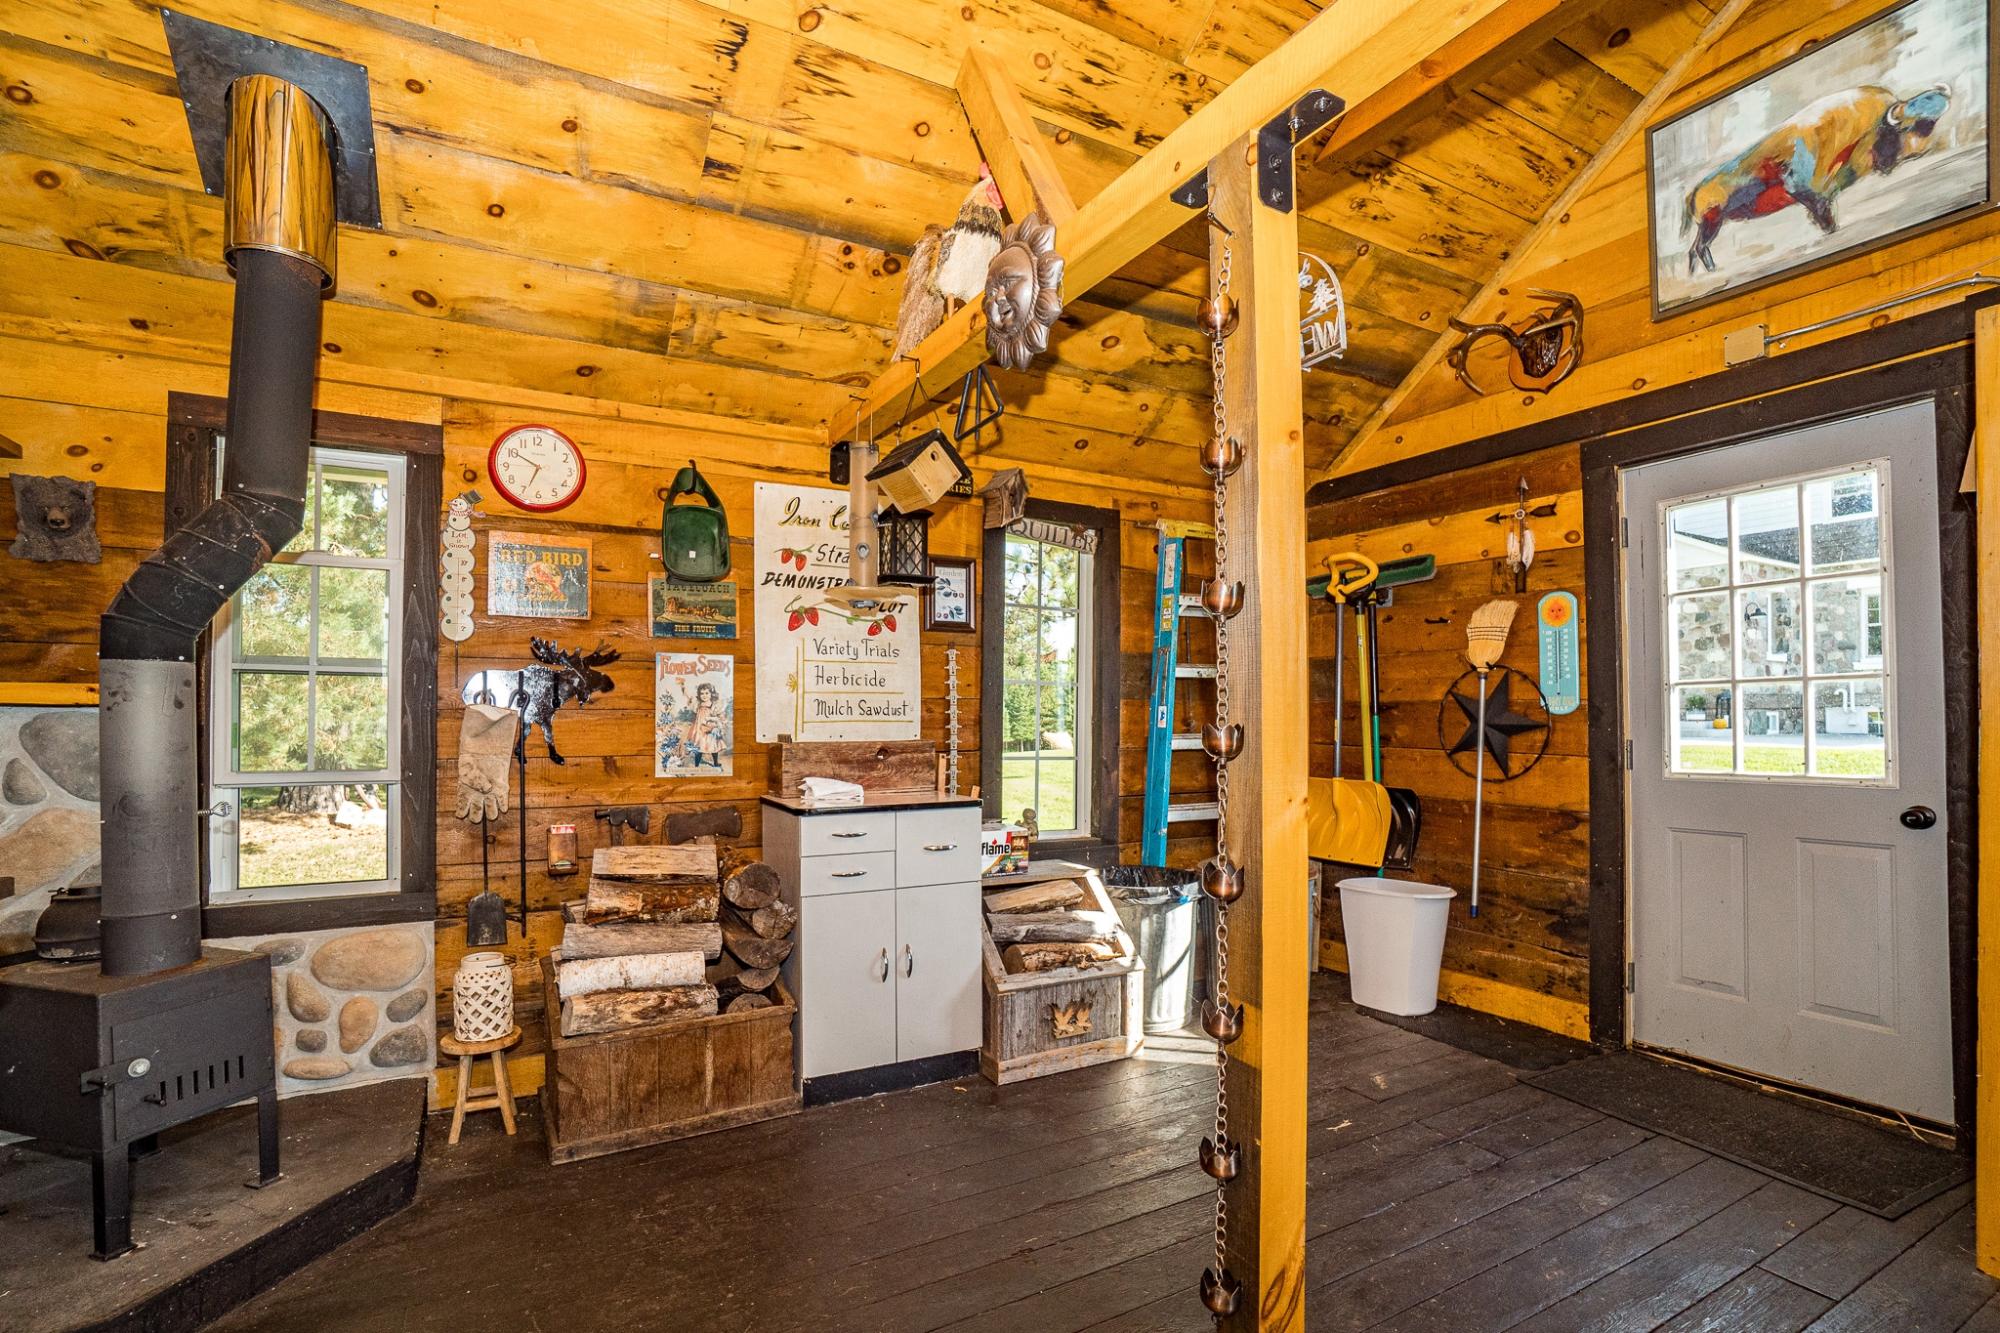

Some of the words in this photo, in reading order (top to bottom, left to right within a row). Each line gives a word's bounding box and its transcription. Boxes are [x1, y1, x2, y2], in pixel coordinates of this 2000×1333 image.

[520, 438, 527, 448] 11
[533, 436, 543, 447] 12
[508, 448, 519, 458] 10
[562, 453, 569, 463] 2
[503, 462, 510, 471] 9
[567, 467, 573, 477] 3
[508, 475, 515, 484] 8
[561, 479, 568, 488] 4
[521, 486, 527, 494] 7
[536, 490, 542, 499] 6
[551, 488, 558, 497] 5
[778, 496, 821, 528] Iron
[500, 548, 537, 563] RED
[542, 551, 583, 566] BIRD
[815, 543, 850, 564] Stra
[760, 571, 850, 589] DEMONSTR
[813, 637, 858, 660] Variety
[861, 638, 900, 658] Trials
[814, 665, 886, 688] Herbicide
[814, 698, 853, 718] Mulch
[858, 699, 909, 717] Sawdust
[981, 842, 1010, 856] flame
